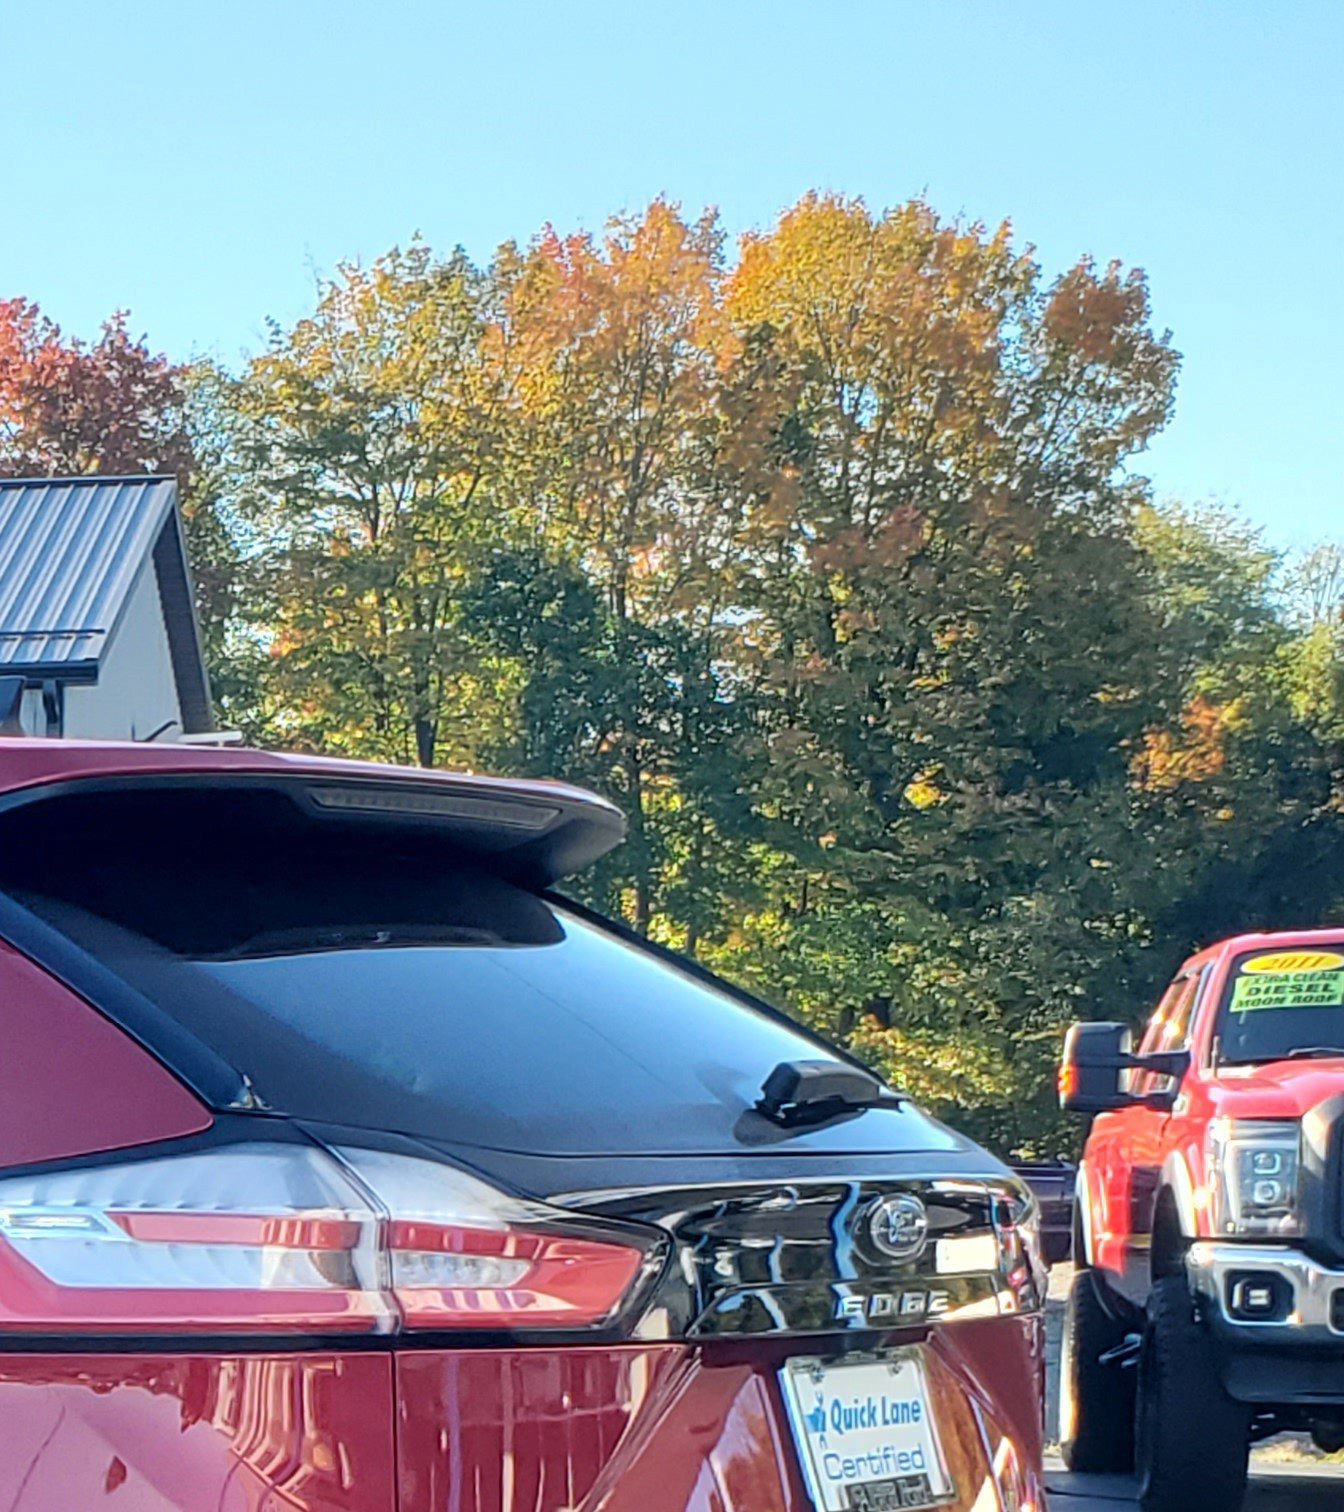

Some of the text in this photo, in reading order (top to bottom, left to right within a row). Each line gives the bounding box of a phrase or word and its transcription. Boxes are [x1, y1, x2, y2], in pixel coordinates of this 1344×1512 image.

[1236, 996, 1286, 1008] MOON
[1246, 984, 1335, 996] DIESEL
[835, 1289, 949, 1319] EDGE
[830, 1395, 922, 1435] Quick Lane
[823, 1443, 926, 1481] Certified
